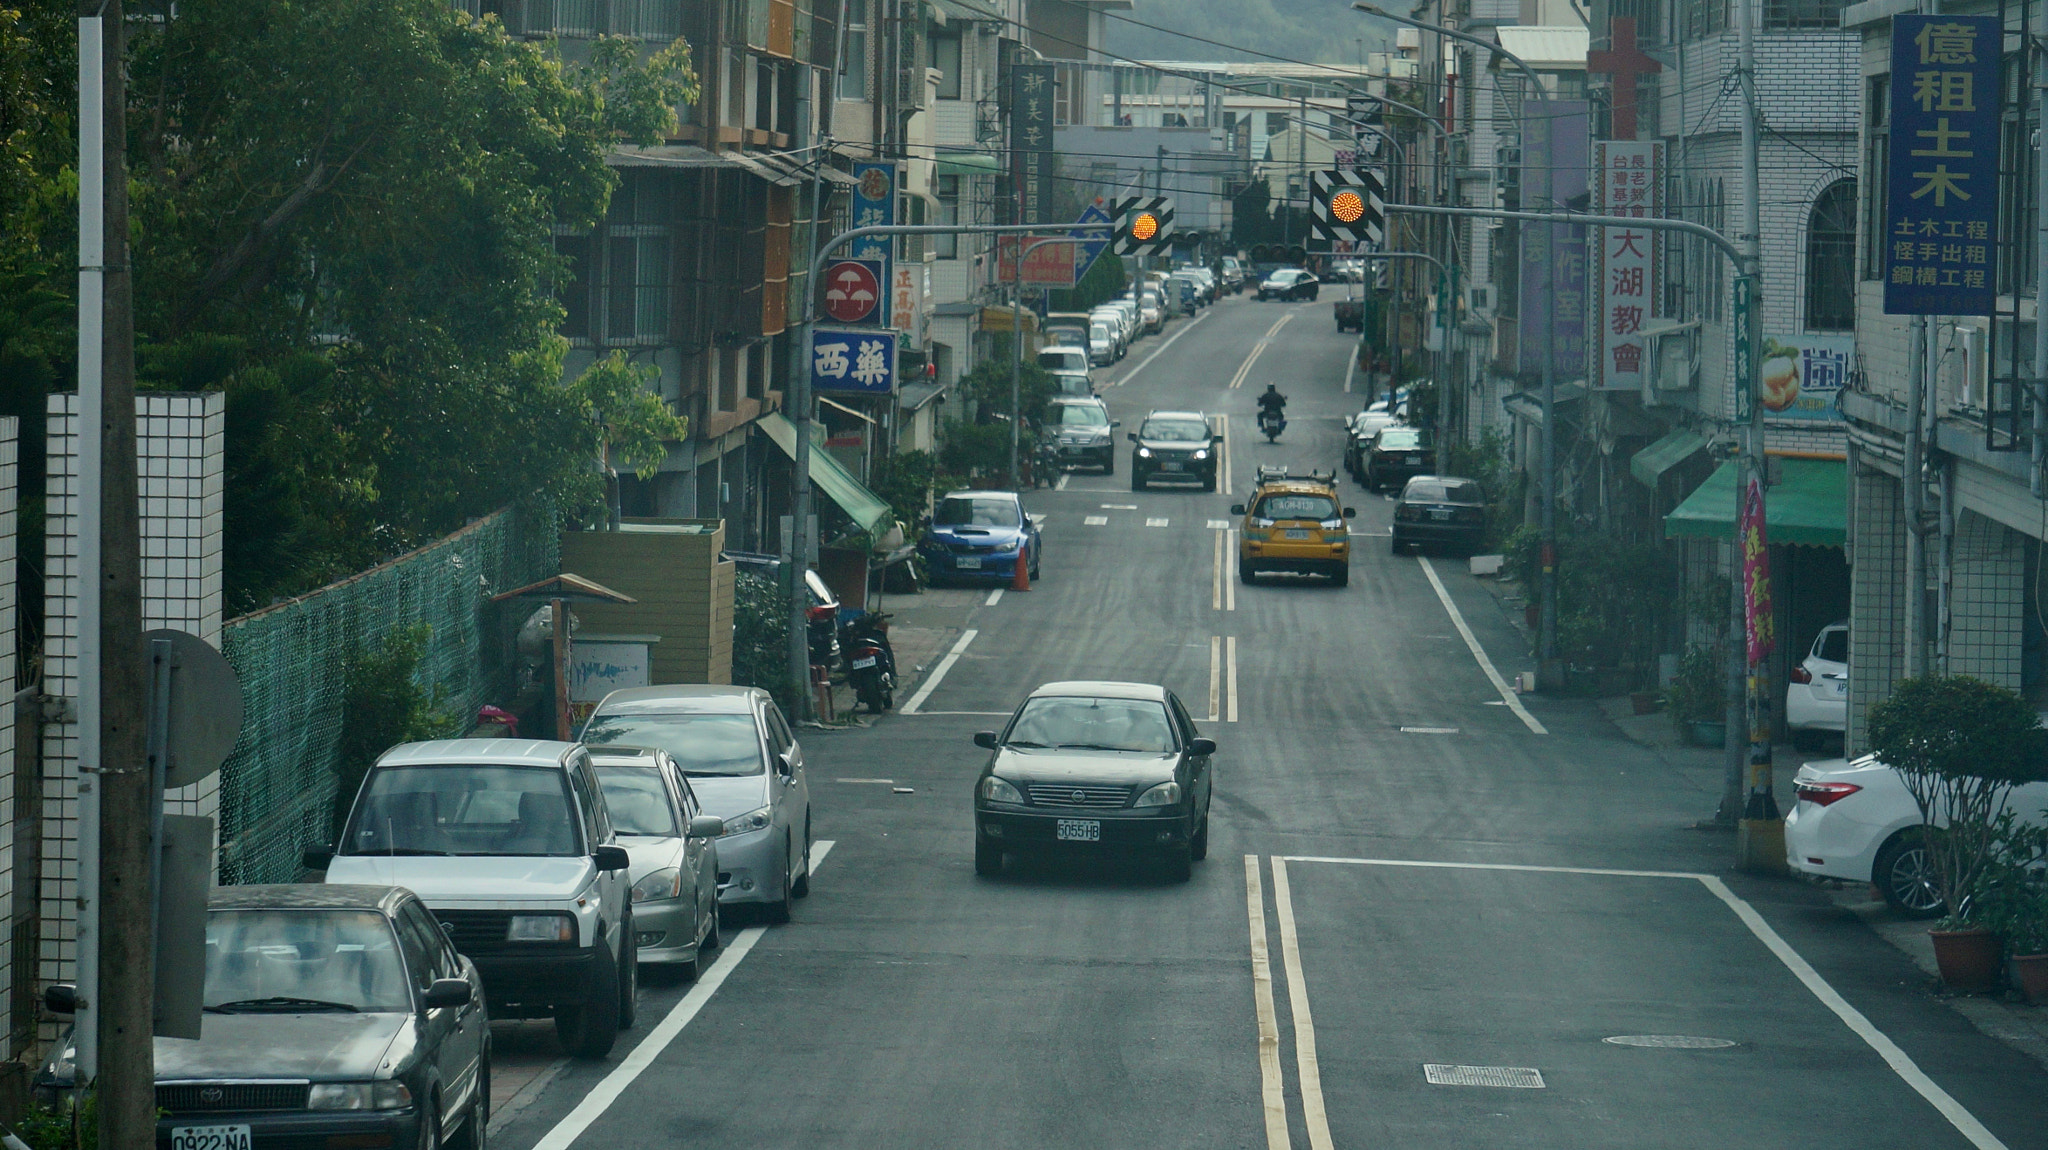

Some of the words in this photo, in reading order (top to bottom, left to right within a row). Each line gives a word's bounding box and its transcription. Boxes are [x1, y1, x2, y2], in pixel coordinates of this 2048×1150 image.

[1910, 22, 1978, 207] 億租土木
[1894, 216, 1988, 241] 土木工程
[1893, 240, 1986, 265] 怪手出租
[1891, 265, 1985, 289] 鋼構工程
[1612, 229, 1645, 374] 大湖教會
[814, 340, 889, 386] 西藥
